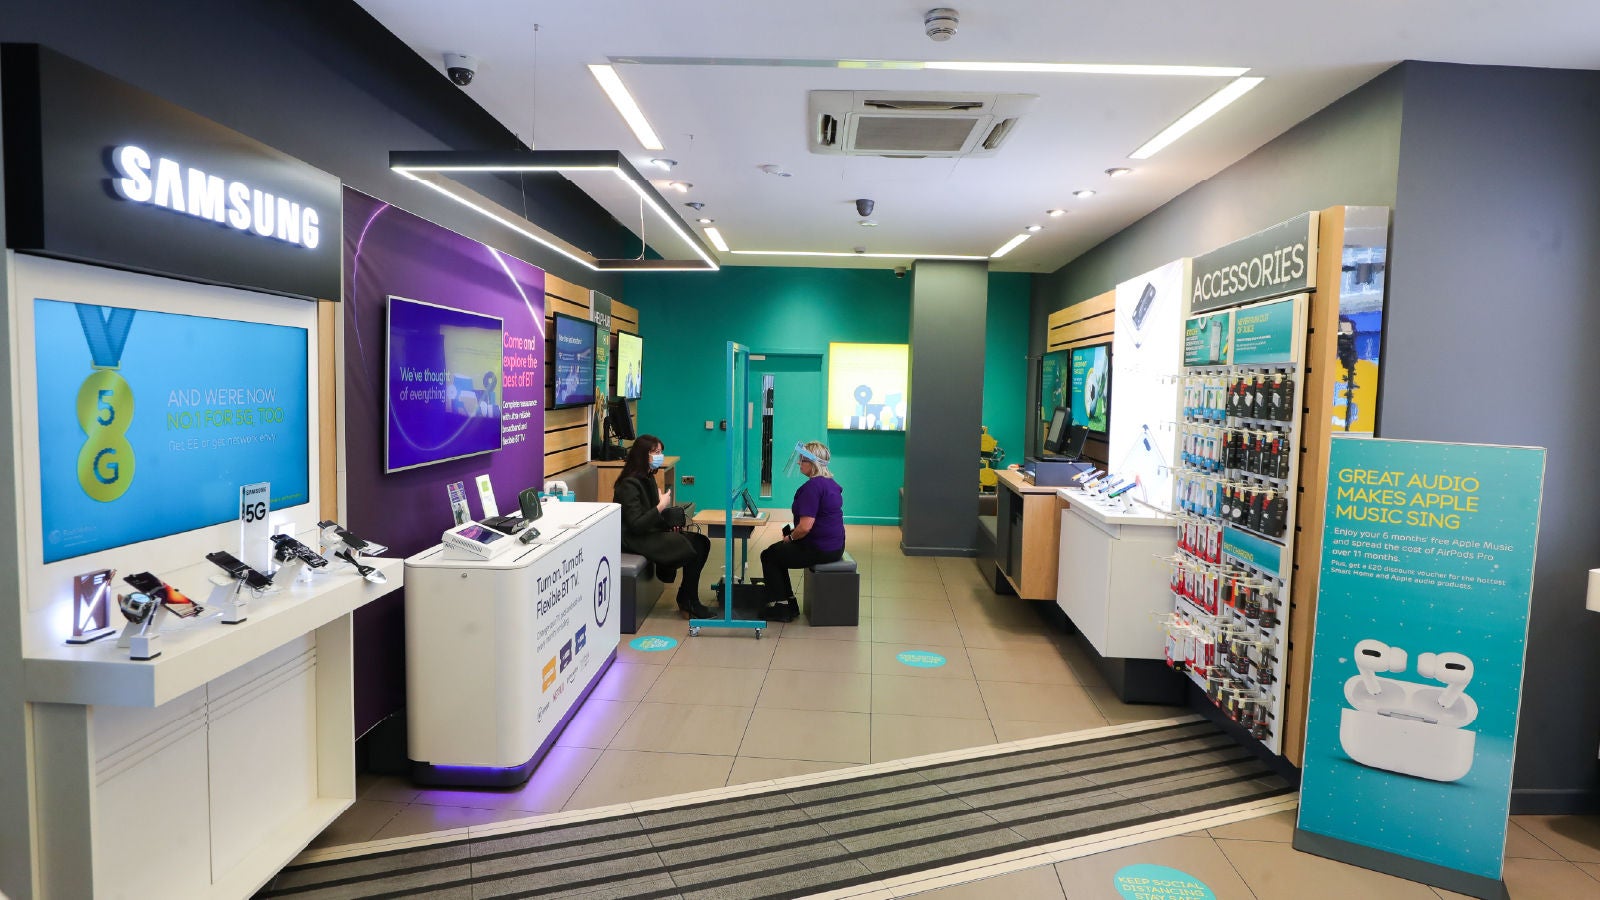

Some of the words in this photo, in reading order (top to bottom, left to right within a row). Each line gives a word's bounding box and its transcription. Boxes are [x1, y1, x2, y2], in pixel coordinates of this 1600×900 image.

[112, 145, 319, 249] SAMSUNG
[1192, 243, 1305, 303] ACCESSORIES
[504, 331, 523, 350] Come
[524, 336, 536, 351] and
[504, 353, 526, 372] explore
[527, 354, 538, 368] the
[400, 366, 422, 382] We've
[424, 368, 450, 385] thought
[503, 372, 517, 387] best
[518, 372, 525, 387] of
[526, 372, 534, 387] BT
[168, 388, 200, 408] AND
[247, 388, 276, 404] NOW
[400, 386, 408, 400] of
[410, 387, 446, 404] everything
[96, 389, 116, 428] 5
[166, 411, 200, 430] NO.1
[204, 409, 233, 428] FOR
[258, 407, 284, 424] TOO
[188, 438, 199, 449] EE
[202, 439, 210, 448] or
[212, 438, 226, 449] get
[228, 435, 258, 445] network
[93, 447, 120, 484] G
[246, 486, 266, 496] SAMSUNG
[1338, 468, 1405, 487] GREAT
[1406, 473, 1480, 493] AUDIO
[1337, 486, 1406, 506] MAKES
[1409, 492, 1480, 512] APPLE
[246, 502, 266, 523] 5G
[1336, 504, 1403, 524] MUSIC
[1406, 510, 1461, 530] SING
[1334, 527, 1358, 538] Enjoy
[1360, 530, 1380, 538] your
[1430, 536, 1450, 545] free
[1452, 539, 1480, 549] Apple
[1483, 541, 1514, 552] Music
[1351, 540, 1382, 549] spread
[1436, 548, 1474, 559] AirPods
[1477, 552, 1494, 561] Pro
[1364, 552, 1400, 562] months.
[537, 577, 551, 596] Turn
[562, 559, 574, 576] Turn
[1384, 565, 1415, 575] discount
[1417, 569, 1447, 579] voucher
[1477, 577, 1506, 586] hottest
[1391, 574, 1412, 584] Apple
[1414, 577, 1435, 586] audio
[537, 588, 561, 619] Flexible
[562, 578, 569, 598] BT
[598, 576, 608, 607] BT
[1122, 884, 1205, 897] DISTANCING
[1152, 880, 1204, 890] SOCIAL
